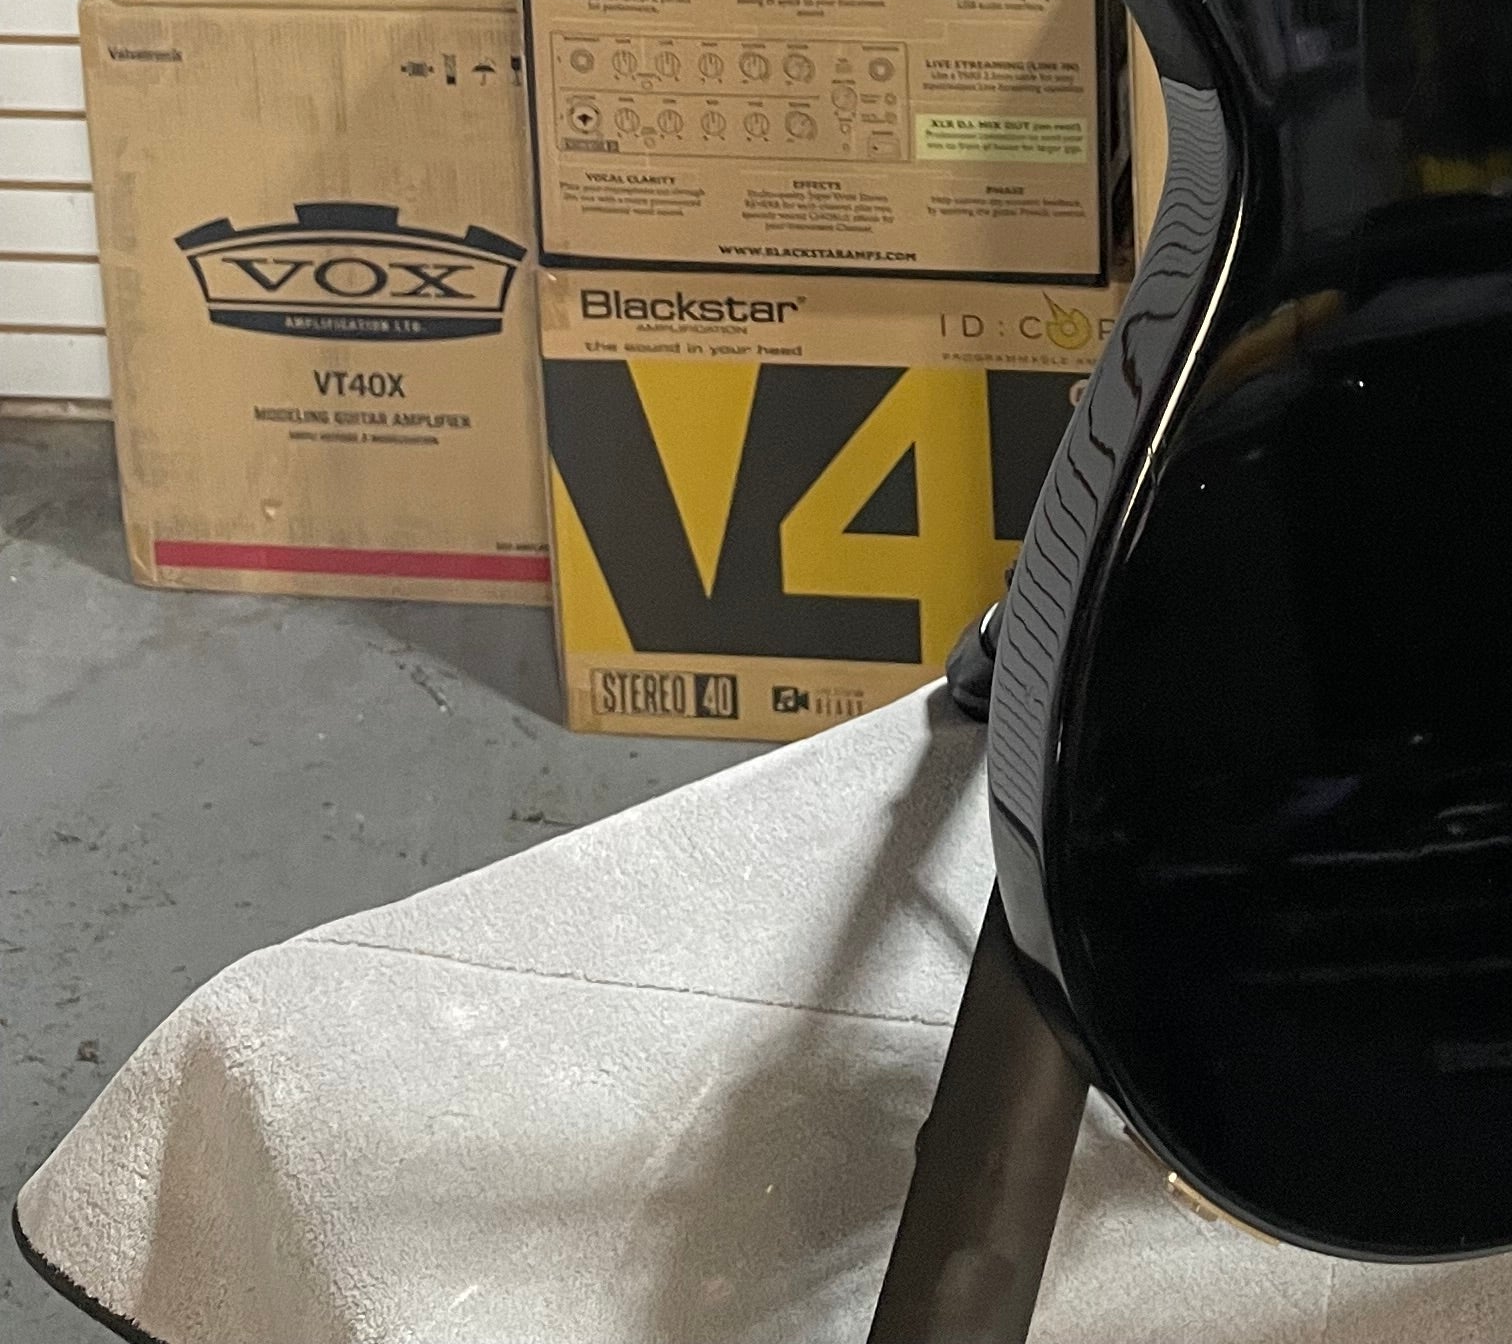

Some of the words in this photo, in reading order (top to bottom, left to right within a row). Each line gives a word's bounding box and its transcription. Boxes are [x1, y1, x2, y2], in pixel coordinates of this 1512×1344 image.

[926, 59, 950, 69] LIVE
[955, 60, 1025, 70] STREAMING
[1004, 121, 1030, 130] OUT
[585, 172, 624, 184] VOCAL
[626, 175, 675, 185] CLARITY
[718, 244, 917, 261] WWW.BLACKSTARAMPS.COM
[222, 257, 476, 299] VOX
[580, 289, 799, 323] Blackstar
[285, 316, 389, 332] AMPLIFICATION
[636, 323, 748, 335] AMPLIFICATION
[585, 341, 617, 352] the
[623, 341, 681, 354] sound
[687, 343, 704, 354] in
[709, 344, 752, 356] your
[757, 345, 803, 356] head
[313, 370, 406, 398] VT40X
[602, 672, 685, 712] STEREO
[701, 676, 733, 715] 40
